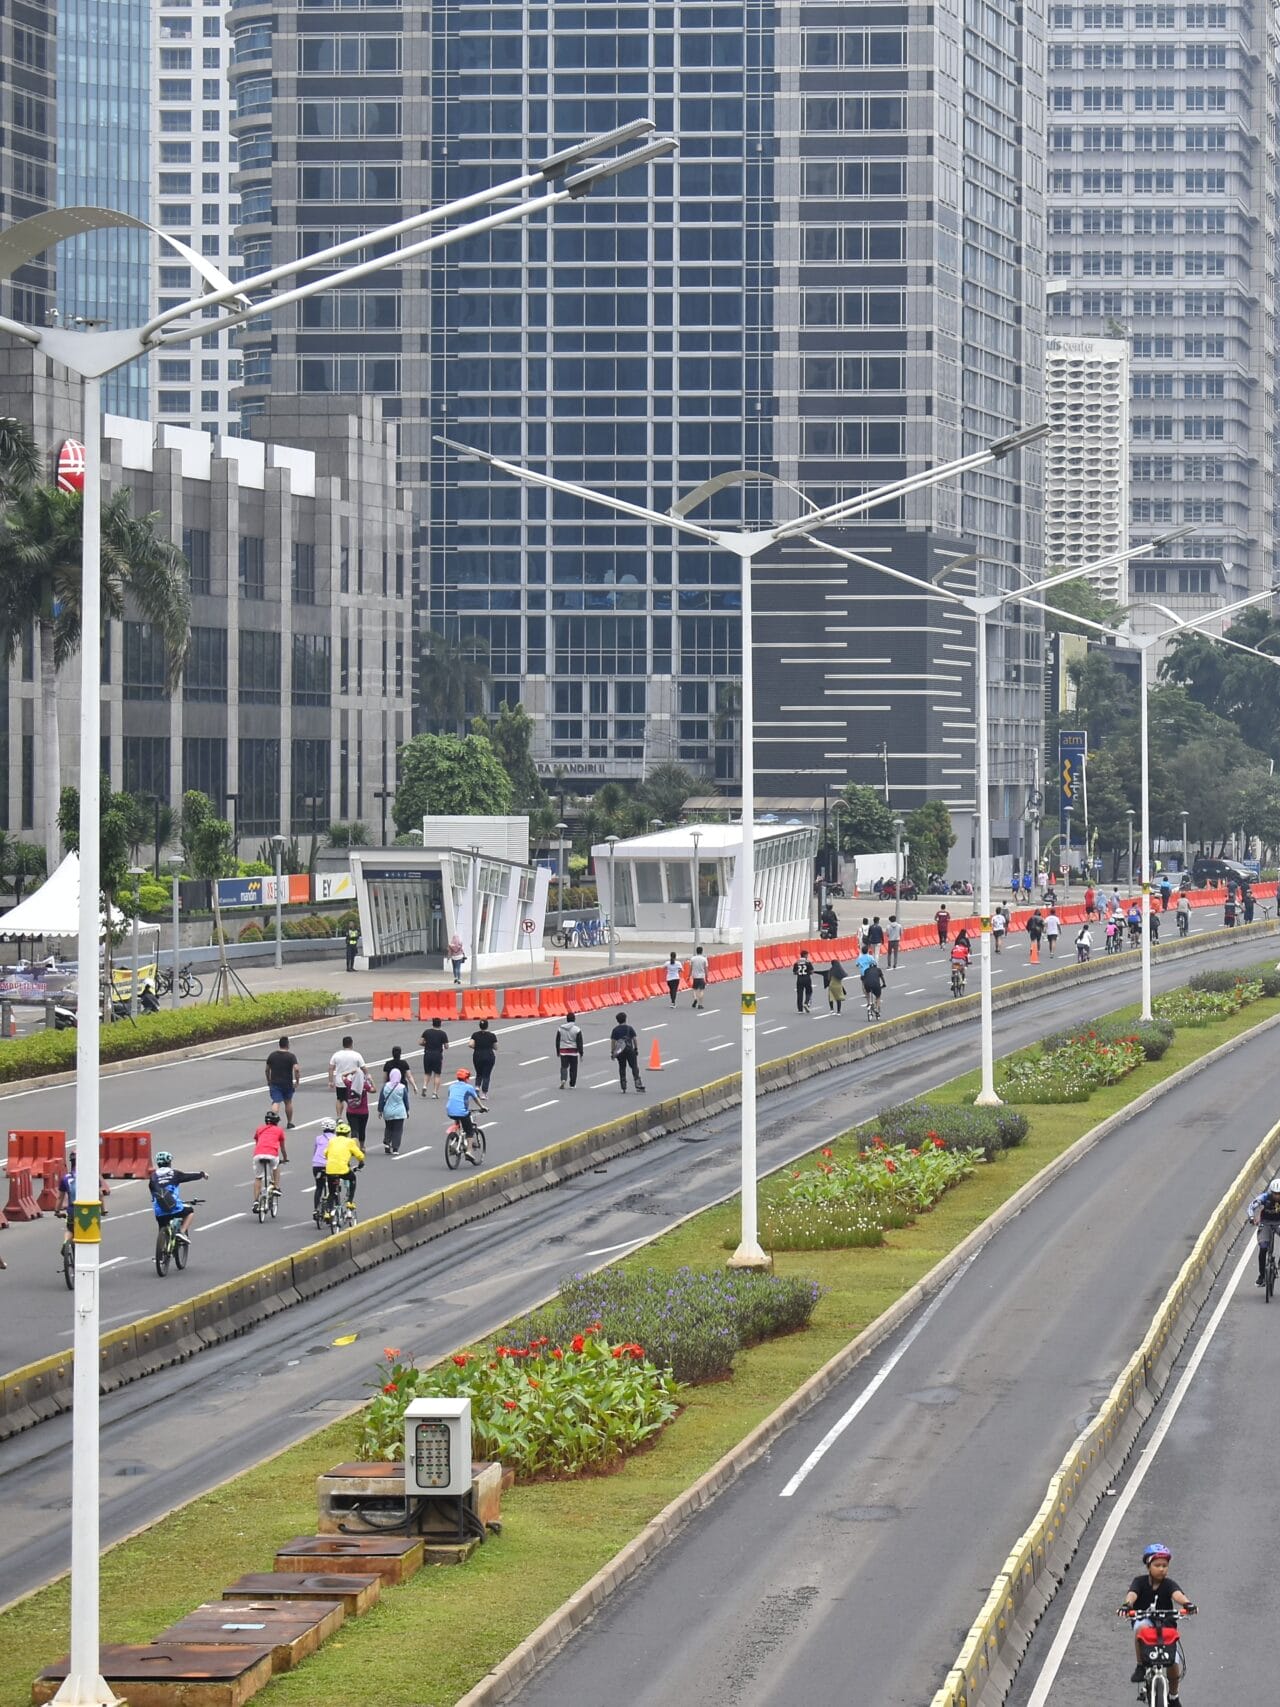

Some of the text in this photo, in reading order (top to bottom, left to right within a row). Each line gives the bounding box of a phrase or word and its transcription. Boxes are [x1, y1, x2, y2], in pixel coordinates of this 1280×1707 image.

[1063, 735, 1083, 745] atm
[322, 879, 332, 898] EY
[797, 964, 808, 976] 22
